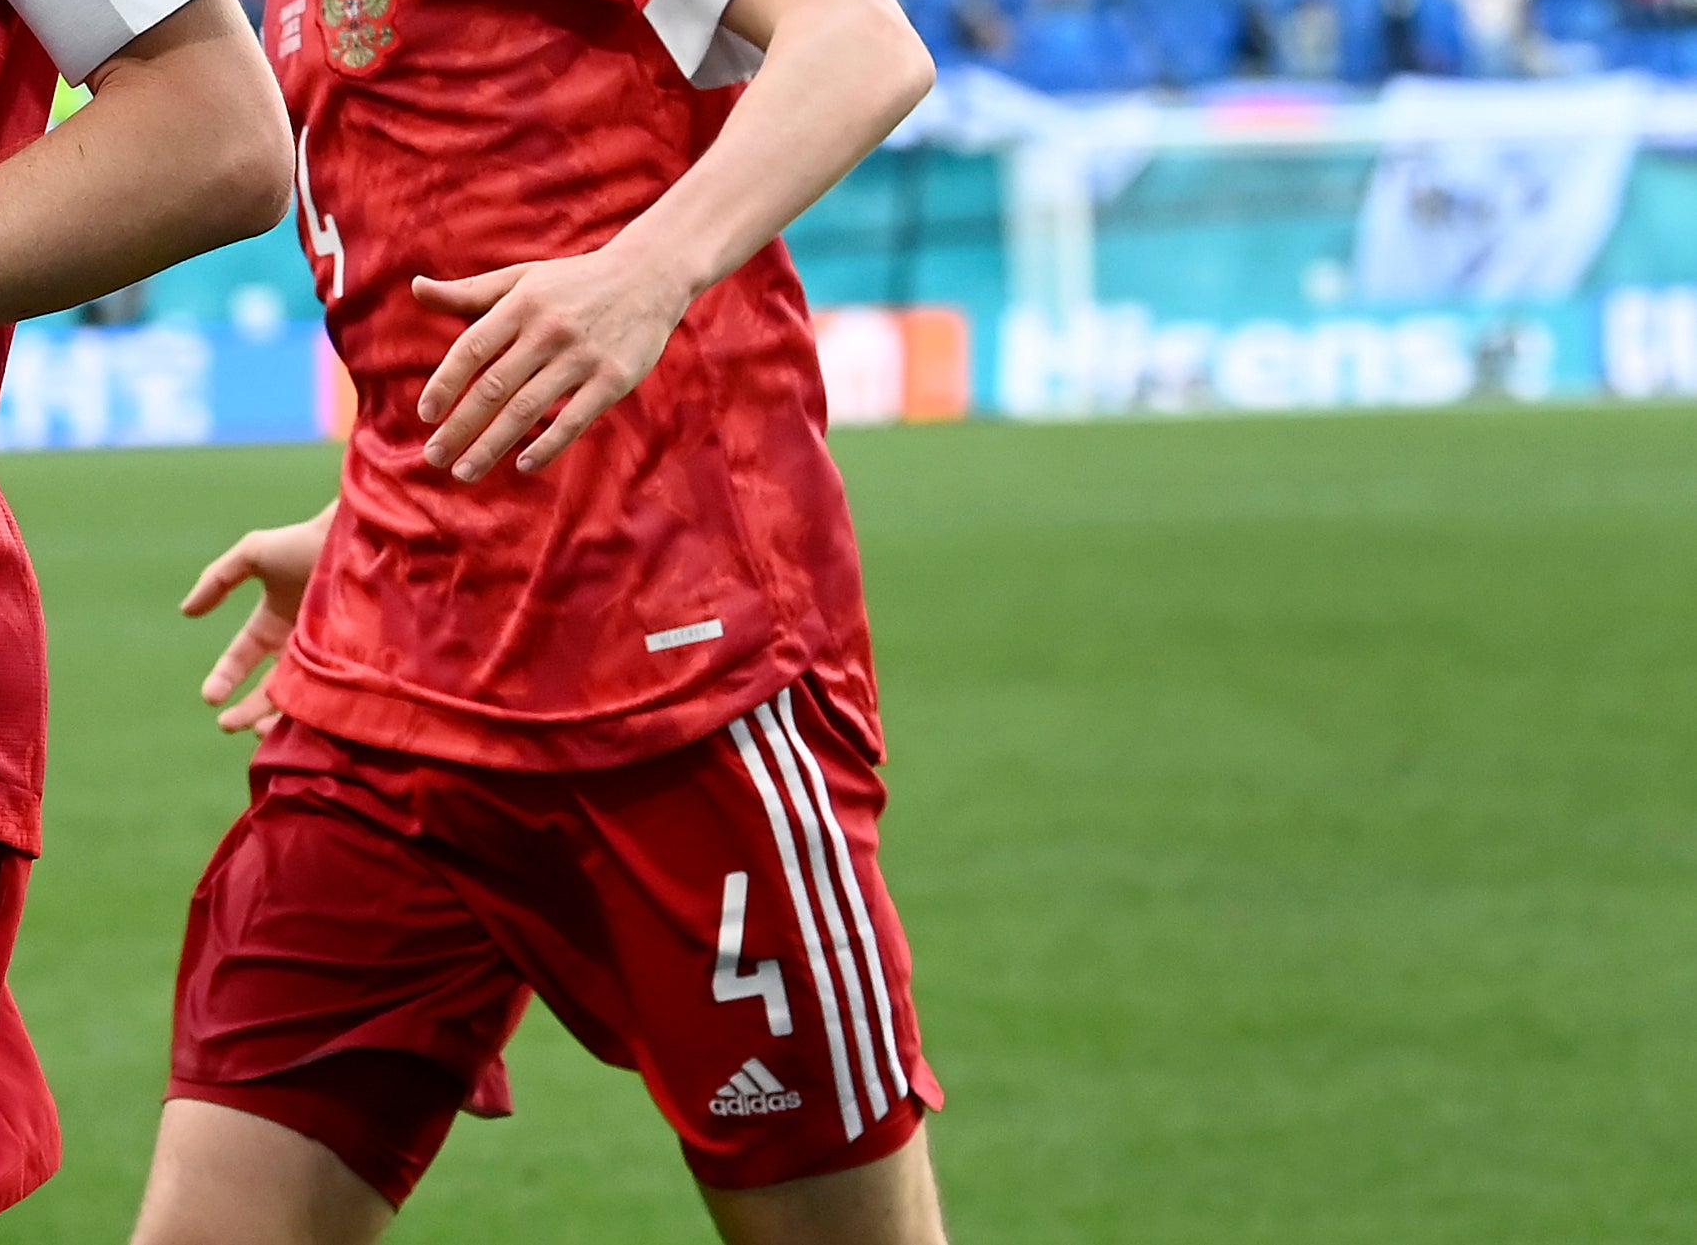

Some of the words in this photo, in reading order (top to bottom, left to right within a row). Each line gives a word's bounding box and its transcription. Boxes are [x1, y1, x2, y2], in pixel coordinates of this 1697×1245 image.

[297, 125, 345, 299] 4
[711, 870, 794, 1037] 4
[708, 1090, 803, 1117] adidas
